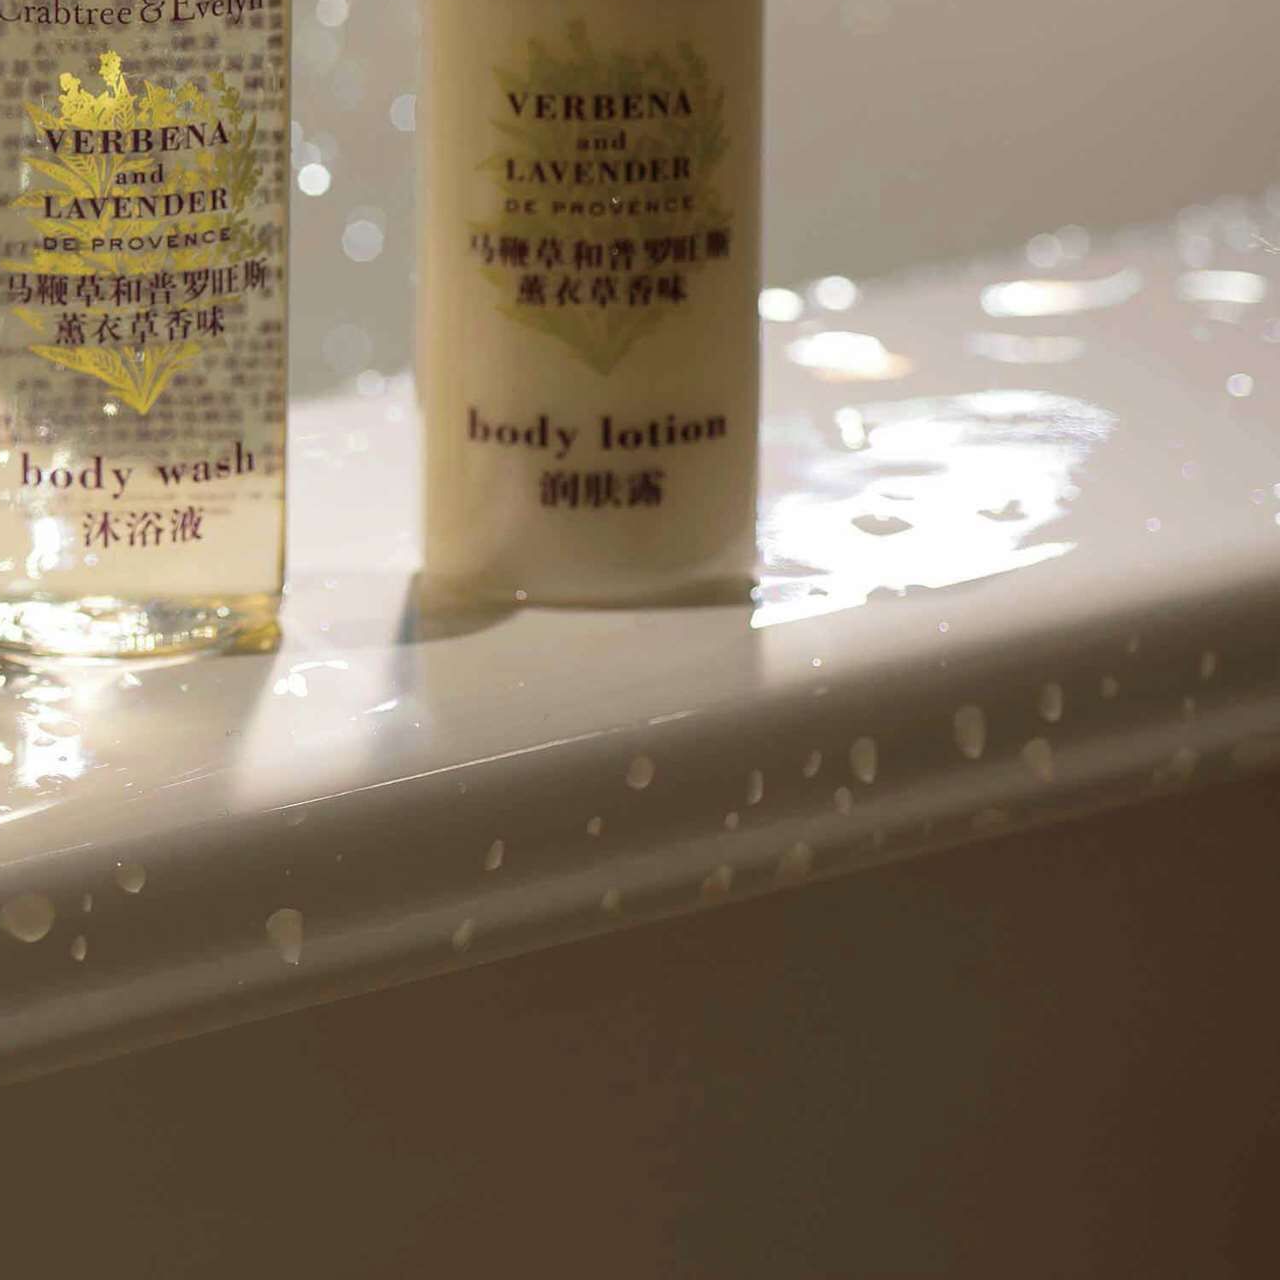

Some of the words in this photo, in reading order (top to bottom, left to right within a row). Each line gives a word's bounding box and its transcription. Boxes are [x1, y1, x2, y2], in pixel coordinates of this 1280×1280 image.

[507, 88, 693, 122] VERBENA
[44, 120, 229, 155] VERBENA
[576, 130, 627, 151] and
[115, 164, 164, 186] and
[505, 156, 691, 184] LAVENDER
[43, 187, 228, 220] LAVENDER
[43, 237, 78, 251] DE
[92, 228, 232, 252] PROVENCE
[7, 257, 269, 308] 马鞭草和普罗旺斯
[55, 306, 226, 345] 薰衣草香味
[467, 407, 578, 459] body
[600, 414, 728, 451] lotion
[21, 453, 134, 499] body
[157, 442, 256, 488] wash
[83, 507, 205, 549] 沐浴液
